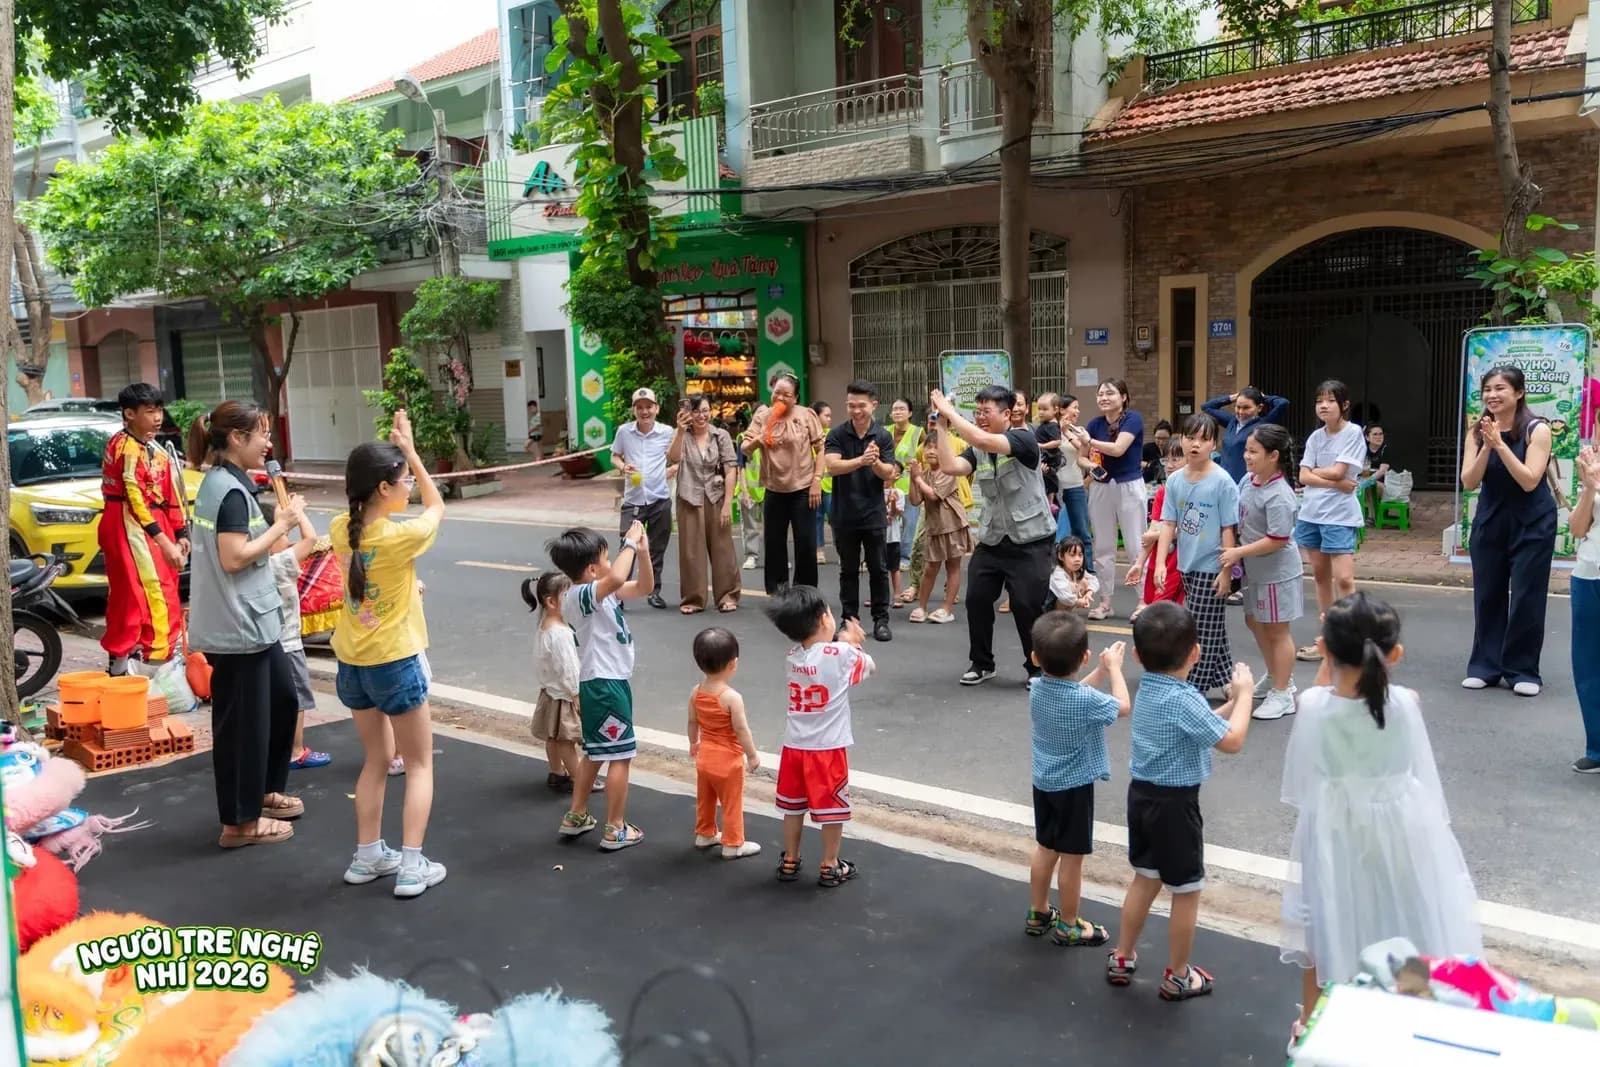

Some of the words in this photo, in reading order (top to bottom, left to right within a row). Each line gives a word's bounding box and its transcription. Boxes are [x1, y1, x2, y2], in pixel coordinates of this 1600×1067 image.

[1532, 358, 1556, 373] HỘI
[1540, 371, 1569, 384] NGHỆ
[1524, 384, 1551, 393] 2026
